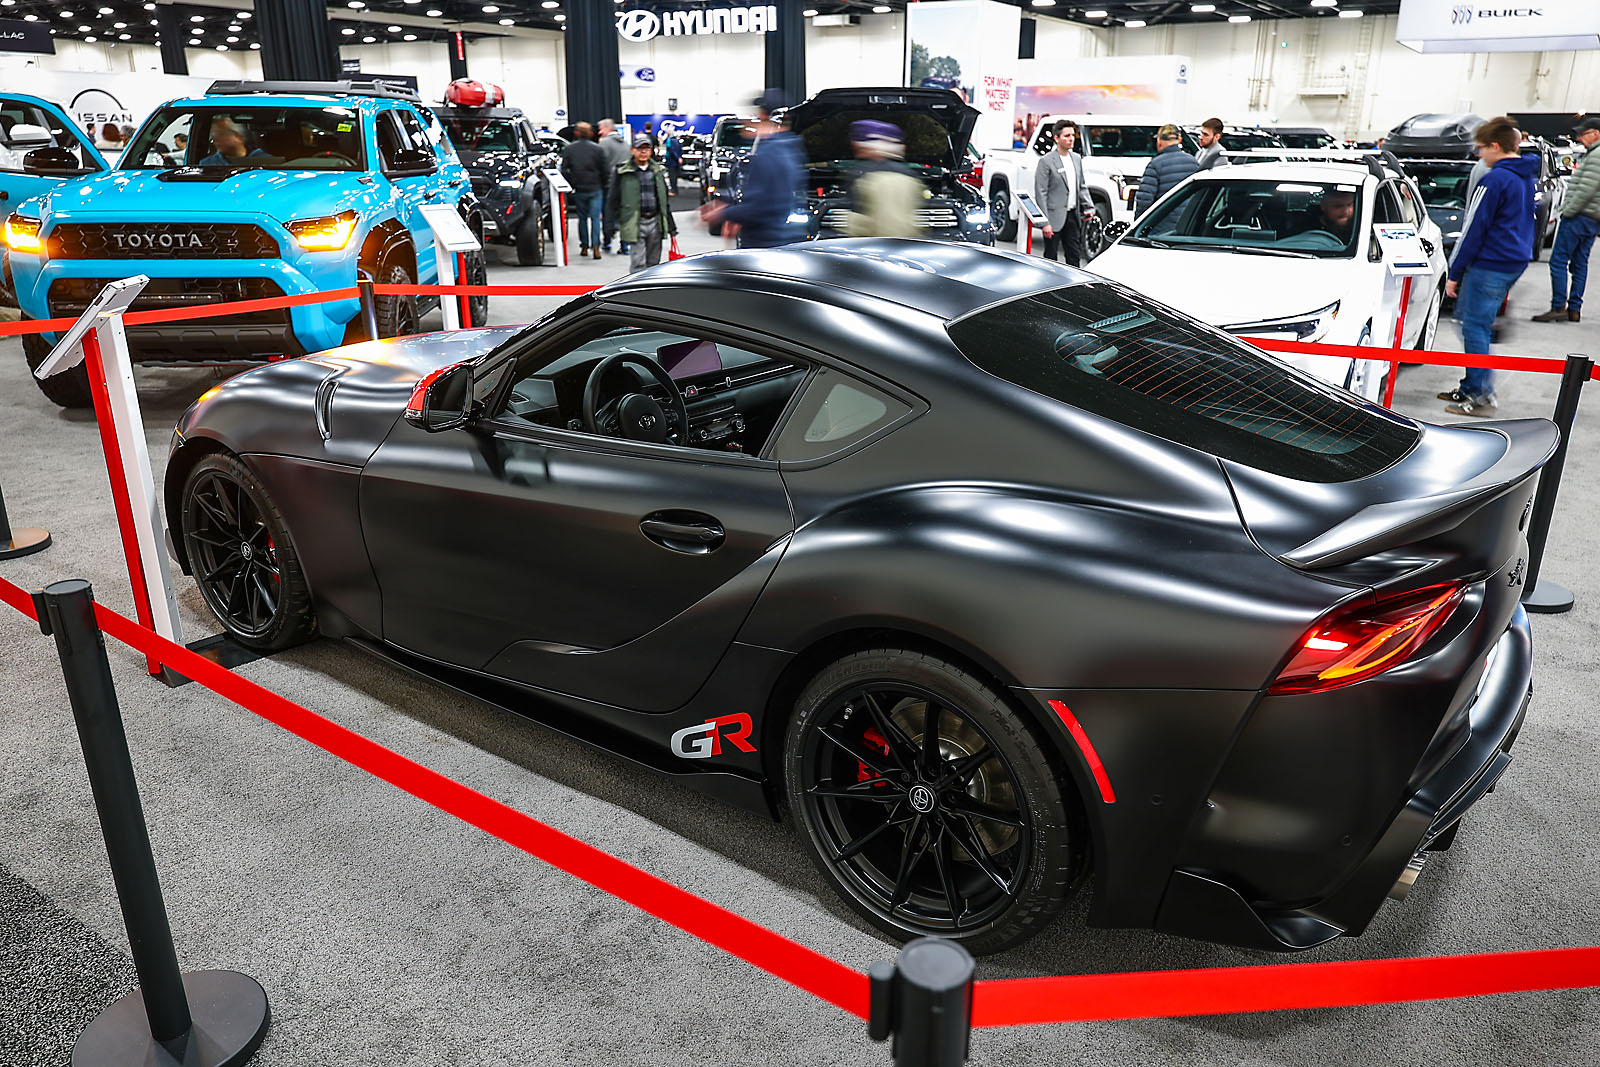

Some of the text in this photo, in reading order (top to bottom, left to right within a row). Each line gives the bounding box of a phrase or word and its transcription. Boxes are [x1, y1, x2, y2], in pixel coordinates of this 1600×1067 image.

[1478, 8, 1544, 18] BUICK
[662, 5, 777, 36] HYUNDAI
[984, 75, 1013, 88] FOR WHAT
[986, 88, 1010, 100] MATTERS
[113, 233, 204, 248] TOYOTA
[670, 711, 758, 759] GR
